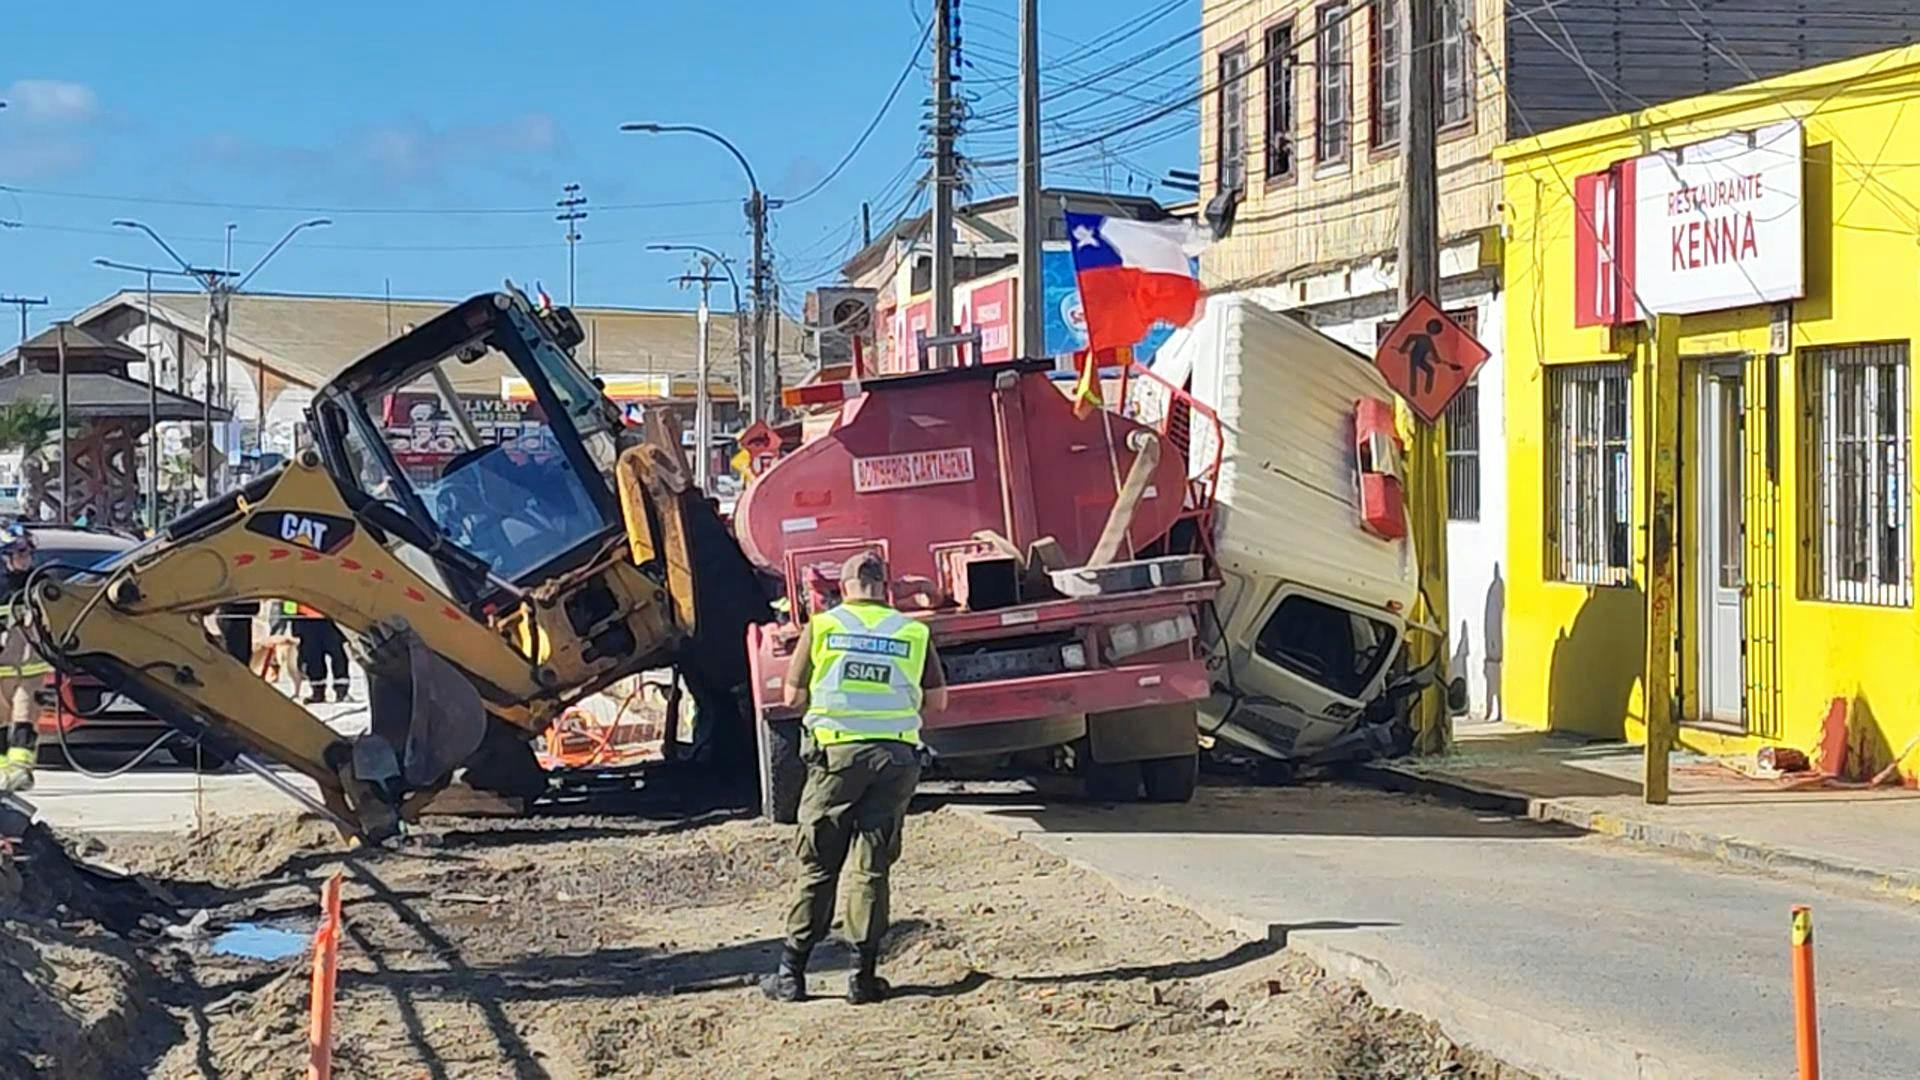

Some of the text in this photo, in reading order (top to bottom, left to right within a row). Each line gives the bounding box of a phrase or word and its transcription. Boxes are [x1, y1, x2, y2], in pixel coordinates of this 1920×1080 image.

[1667, 174, 1763, 216] RESTAURANTE
[1672, 211, 1758, 271] KENNA
[912, 450, 970, 481] CARTAGENA
[281, 514, 328, 550] CAT
[848, 664, 887, 681] SIAT
